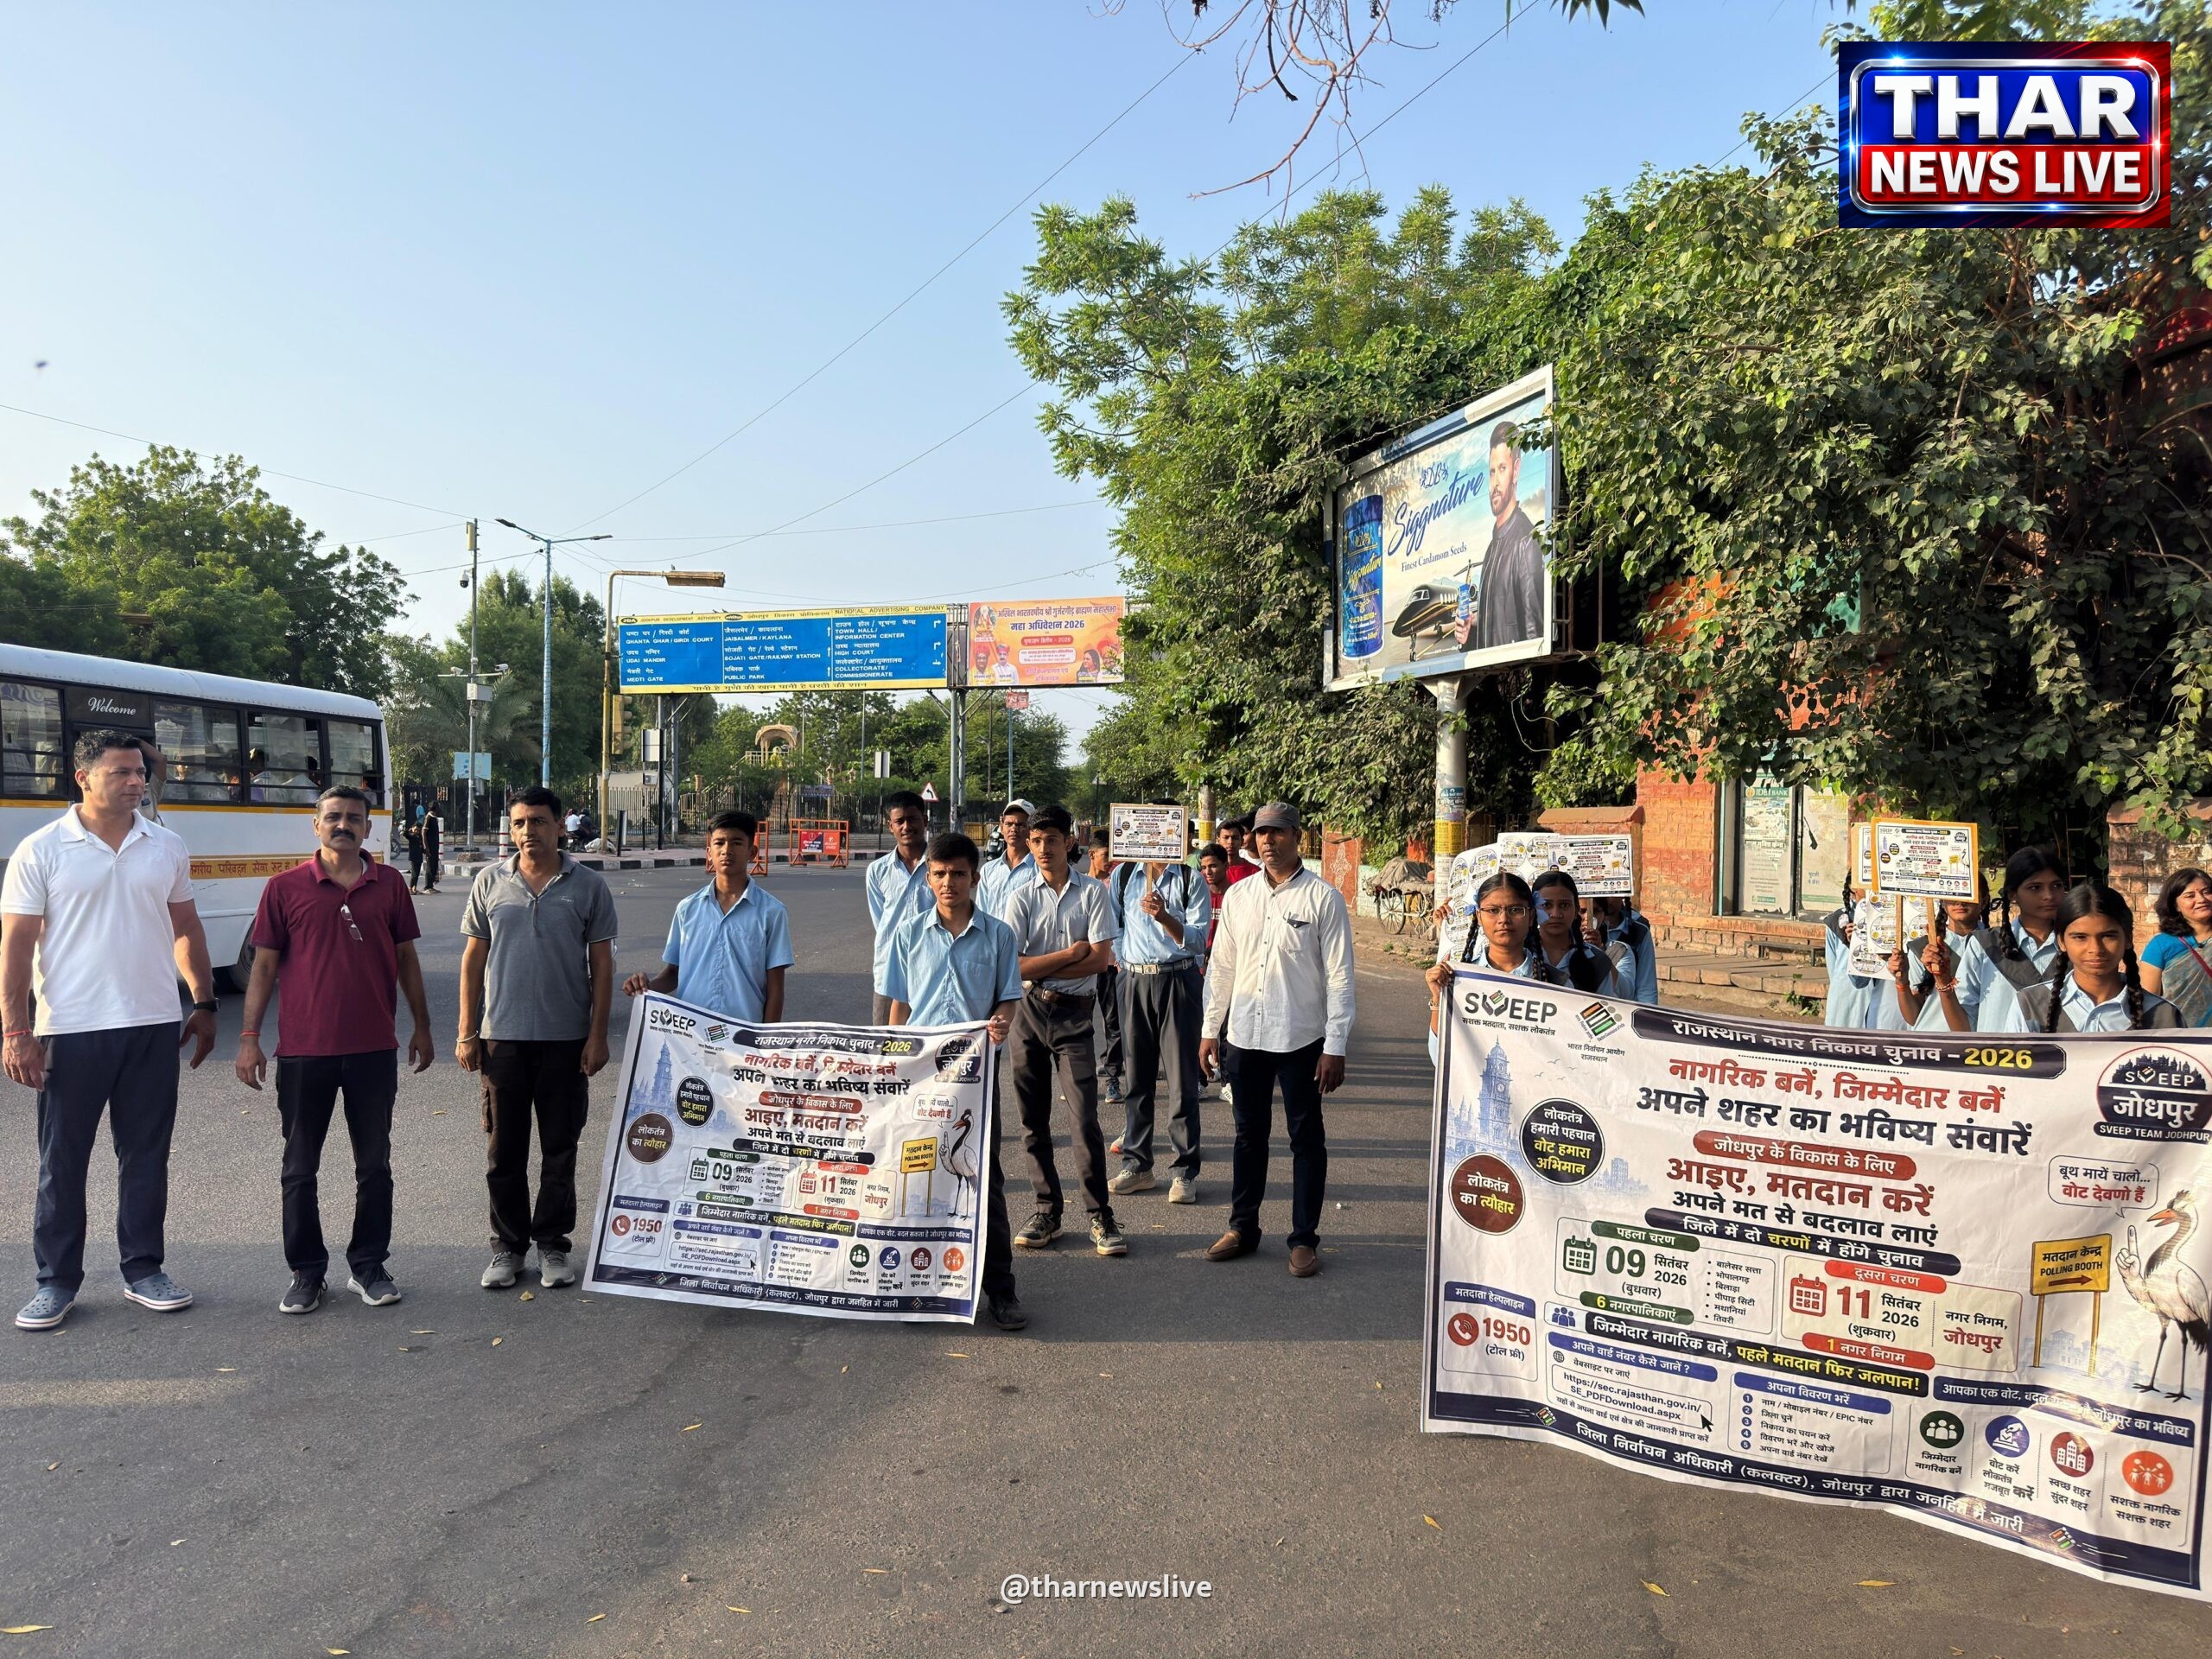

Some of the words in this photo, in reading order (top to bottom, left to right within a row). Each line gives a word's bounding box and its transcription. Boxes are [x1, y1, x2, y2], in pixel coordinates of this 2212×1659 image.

[1402, 558, 1417, 574] Finest
[1418, 551, 1450, 568] Cardamom
[1451, 543, 1467, 559] Seeds
[1010, 622, 1026, 632] महा
[1028, 620, 1062, 632] अधिवेशन
[1065, 620, 1084, 629] 2026
[88, 696, 137, 715] Welcome
[754, 1036, 795, 1046] राजस्थान
[817, 1033, 848, 1046] निकाय
[849, 1039, 875, 1052] चुनाव
[882, 1040, 912, 1052] 2026
[1671, 1020, 1757, 1044] राजस्थान
[1761, 1035, 1805, 1051] नगर
[1810, 1038, 1878, 1057] निकाय
[1883, 1045, 1942, 1065] चुनाव
[1964, 1047, 2032, 1070] 2026
[745, 1052, 792, 1070] नागरिक
[1580, 1053, 1608, 1063] राजस्थान
[1605, 1048, 1625, 1057] आयोग
[734, 1068, 766, 1084] अपने
[825, 1077, 869, 1095] भविष्य
[874, 1078, 912, 1096] संवारें
[1669, 1058, 1768, 1089] नागरिक
[1775, 1068, 1823, 1099] बनें,
[1833, 1071, 1950, 1109] जिम्मेदार
[1958, 1085, 2006, 1114] बनें
[1544, 1106, 1584, 1124] लोकतंत्र
[2113, 1090, 2198, 1128] जोधपुर
[638, 1125, 665, 1136] लोकतंत्र
[792, 1112, 842, 1131] मतदान
[1636, 1086, 1709, 1118] अपने
[1718, 1098, 1782, 1128] शहर
[1789, 1107, 1832, 1134] का
[1840, 1108, 1937, 1146] भविष्य
[1946, 1117, 2033, 1156] संवारें
[1530, 1121, 1560, 1136] हमारी
[1561, 1128, 1596, 1142] पहचान
[2099, 1124, 2132, 1135] SVEEP
[2134, 1128, 2162, 1138] TEAM
[2164, 1131, 2210, 1141] JODHPUR
[1535, 1137, 1555, 1153] वोट
[1558, 1143, 1591, 1159] हमारा
[1713, 1135, 1764, 1161] जोधपुर
[1770, 1141, 1784, 1159] के
[1789, 1144, 1840, 1166] विकास
[1844, 1151, 1859, 1168] के
[1864, 1154, 1896, 1175] लिए
[1536, 1156, 1586, 1175] अभिमान
[2059, 1165, 2078, 1180] बूथ
[840, 1186, 856, 1197] 2026
[1467, 1172, 1510, 1193] लोकतंत्र
[1666, 1158, 1756, 1196] आइए,
[1766, 1172, 1872, 1209] मतदान
[1882, 1183, 1935, 1217] करें
[2062, 1182, 2088, 1198] वोट
[2092, 1185, 2132, 1201] देवणो
[864, 1193, 888, 1208] जोधपुर
[1460, 1192, 1477, 1205] का
[1480, 1194, 1515, 1214] त्यौहार
[632, 1217, 663, 1234] 1950
[1673, 1191, 1726, 1214] अपने
[1732, 1200, 1768, 1221] मत
[1774, 1203, 1796, 1224] से
[1802, 1211, 1885, 1238] बदलाव
[1891, 1224, 1938, 1247] लाएं
[1617, 1226, 1646, 1242] पहला
[1649, 1232, 1675, 1246] चरण
[1683, 1215, 1719, 1235] जिले
[1725, 1223, 1739, 1238] में
[1744, 1226, 1762, 1242] दो
[1768, 1230, 1812, 1250] चरणों
[1817, 1238, 1832, 1253] में
[1838, 1241, 1871, 1259] होंगे
[1878, 1249, 1924, 1268] चुनाव
[1605, 1245, 1646, 1278] 09
[1654, 1253, 1689, 1271] सितंबर
[2042, 1249, 2079, 1262] मतदान
[2080, 1245, 2103, 1257] केन्द्र
[1654, 1270, 1688, 1286] 2026
[2040, 1264, 2073, 1277] POLLING
[2075, 1261, 2103, 1272] BOOTH
[1621, 1281, 1662, 1300] (बुधवार)
[1596, 1295, 1606, 1308] 6
[1610, 1299, 1677, 1321] नगरपालिकाएं
[1836, 1286, 1871, 1319] 11
[1882, 1293, 1922, 1312] सितंबर
[1882, 1312, 1919, 1328] 2026
[1483, 1317, 1531, 1346] 1950
[1943, 1327, 2004, 1354] जोधपुर
[1736, 1345, 1769, 1363] पहले
[1772, 1351, 1821, 1373] मतदान
[1824, 1361, 1854, 1379] फिर
[1859, 1368, 1920, 1391] जलपान!
[1563, 1372, 1701, 1413] https://sec.rajasthan.gov.in/
[1570, 1386, 1681, 1421] SE_PDFDownload.aspx
[1576, 1421, 1607, 1445] जिला
[1613, 1434, 1667, 1459] निर्वाचन
[1673, 1450, 1732, 1474] अधिकारी
